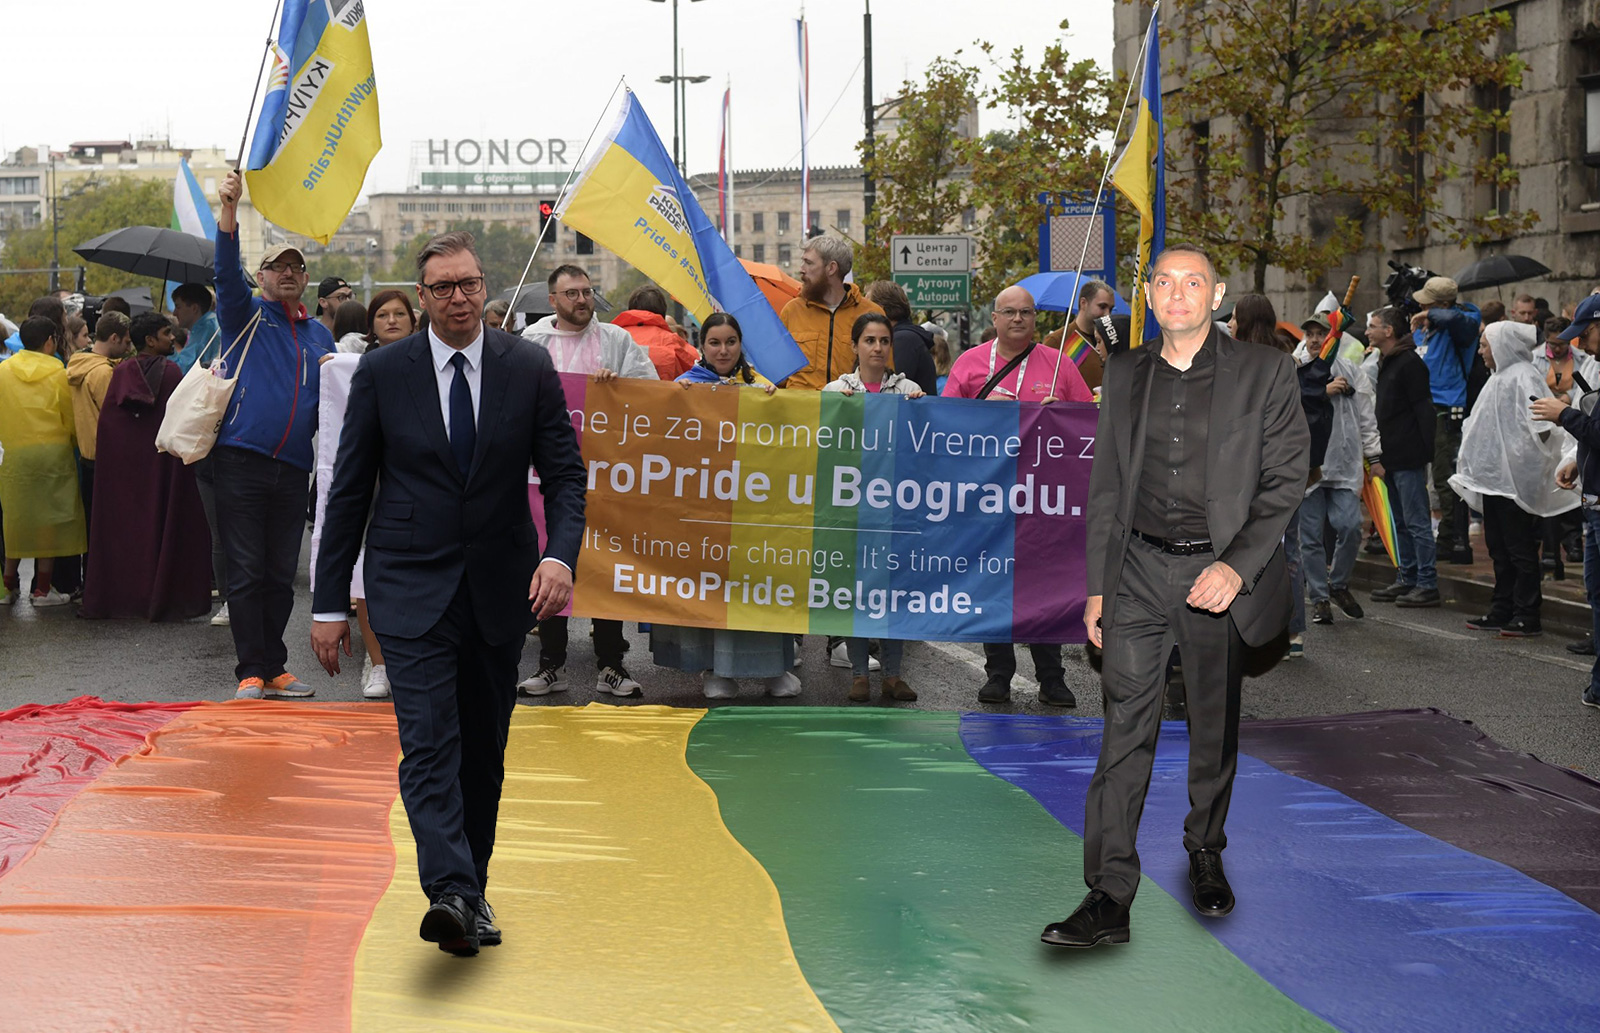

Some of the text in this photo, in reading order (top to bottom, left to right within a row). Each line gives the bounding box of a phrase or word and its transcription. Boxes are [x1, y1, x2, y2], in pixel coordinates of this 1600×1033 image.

[428, 138, 568, 166] HONOR
[648, 196, 682, 231] PRIDE
[634, 217, 678, 260] Prides
[916, 243, 958, 254] Центар
[916, 256, 954, 266] Centar
[917, 278, 962, 290] Аутопут
[917, 291, 960, 304] Autoput
[618, 403, 650, 445] je
[664, 416, 702, 441] za
[718, 419, 893, 452] promenu!
[907, 420, 1021, 457] Vreme
[1032, 426, 1065, 467] je
[1078, 436, 1095, 459] z
[528, 454, 1081, 522] roPride u Beogradu.
[631, 531, 691, 558] time
[701, 536, 738, 562] for
[747, 540, 850, 574] change.
[910, 547, 968, 574] time
[979, 550, 1016, 575] for
[613, 562, 983, 620] EuroPride Belgrade.
